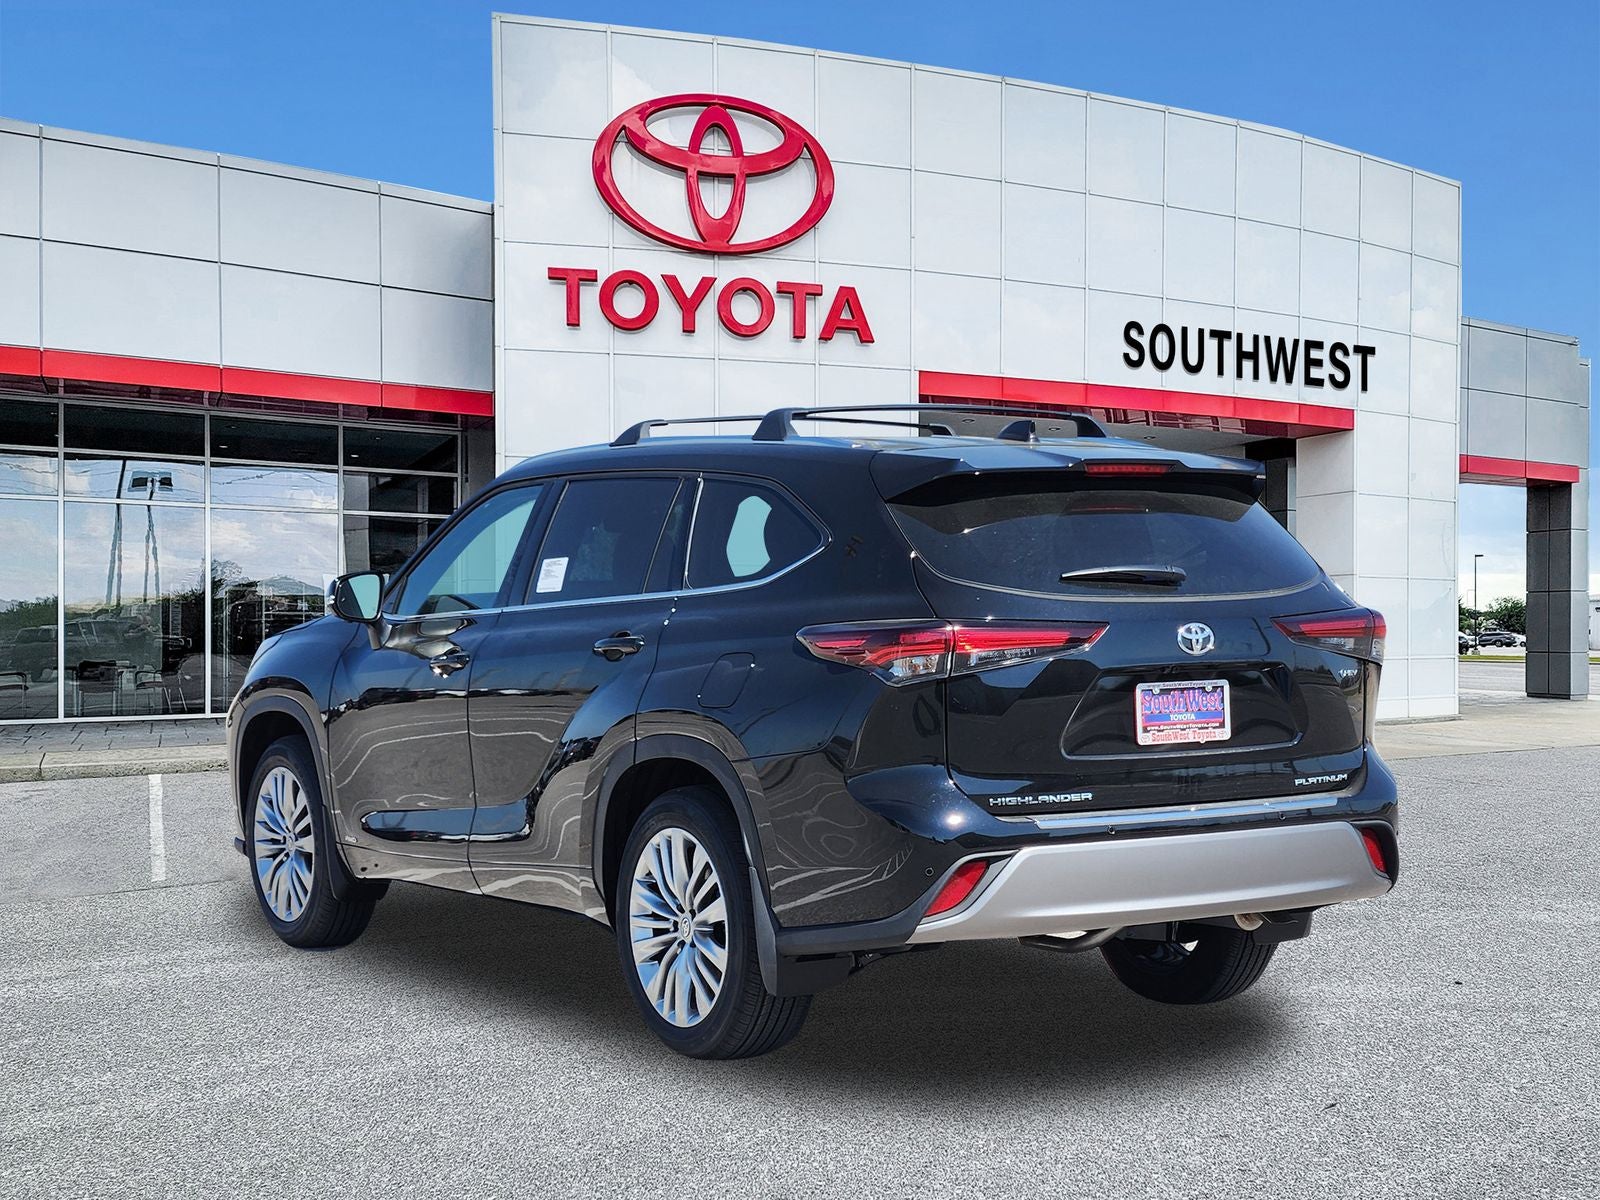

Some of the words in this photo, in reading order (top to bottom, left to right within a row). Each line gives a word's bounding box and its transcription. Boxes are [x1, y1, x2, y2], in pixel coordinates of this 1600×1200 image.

[547, 267, 875, 343] TOYOTA
[1122, 320, 1376, 392] SOUTHWEST
[1141, 688, 1224, 714] SouthWest
[1169, 713, 1196, 721] TOYOTA
[1151, 731, 1190, 742] SouthWest
[1192, 730, 1217, 741] Toyota
[1294, 773, 1348, 786] PLATINUM
[989, 792, 1093, 806] HIGHLANDER
